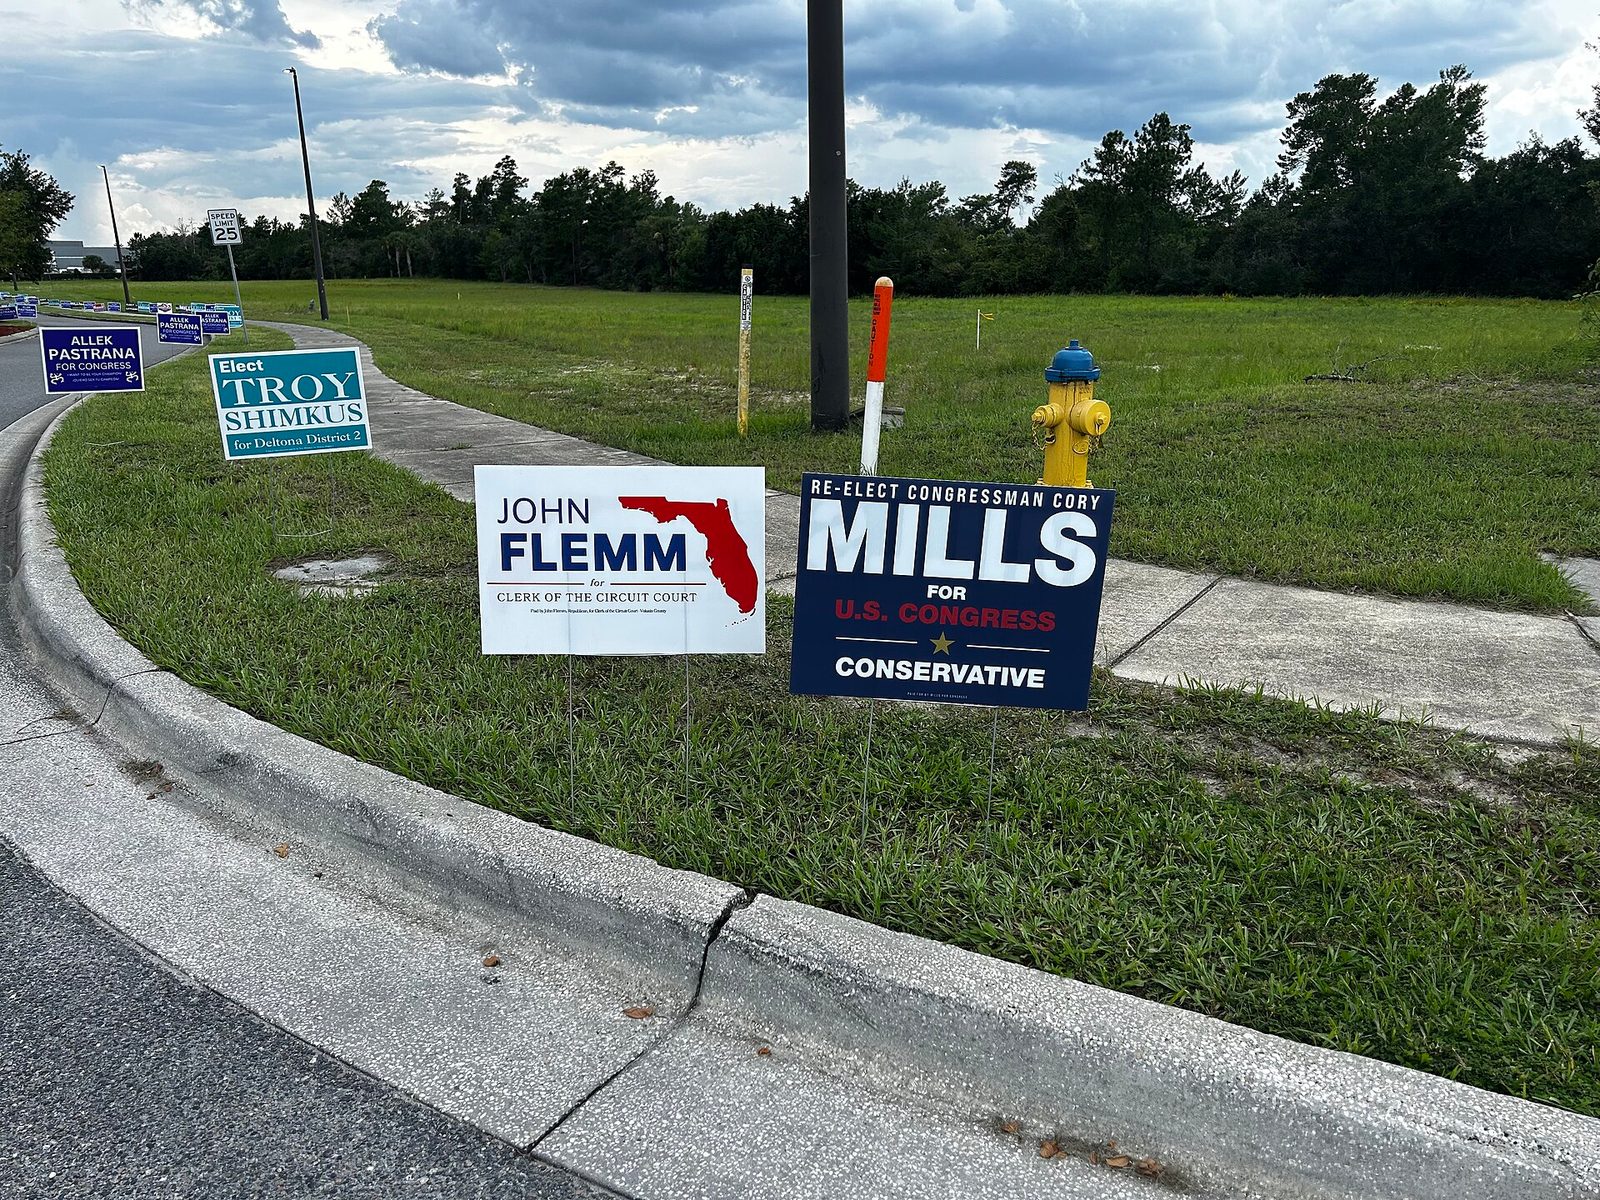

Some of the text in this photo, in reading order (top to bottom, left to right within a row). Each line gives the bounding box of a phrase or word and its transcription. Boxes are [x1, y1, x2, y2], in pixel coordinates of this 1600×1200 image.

[215, 228, 238, 240] 25
[160, 322, 199, 330] PASTRANA
[71, 336, 113, 345] ALLEK
[49, 348, 135, 360] PASTRANA
[78, 362, 131, 370] CONGRESS
[219, 359, 264, 373] Elect
[222, 372, 355, 405] TROY
[225, 403, 363, 431] SHIMKUS
[234, 439, 252, 450] for
[254, 436, 303, 448] Deltona
[306, 433, 350, 444] District
[353, 430, 361, 440] 2
[811, 480, 1100, 510] RE-ELECT CONGRESSMAN CORY
[497, 497, 590, 524] JOHN
[806, 498, 1098, 587] MILLS
[500, 533, 687, 572] FLEMM
[590, 578, 605, 588] for
[497, 592, 697, 602] CLERK OF THE CIRCUIT COURT
[927, 585, 966, 600] FOR
[835, 600, 1056, 632] U.S. CONGRESS
[835, 657, 1046, 689] CONSERVATIVE
